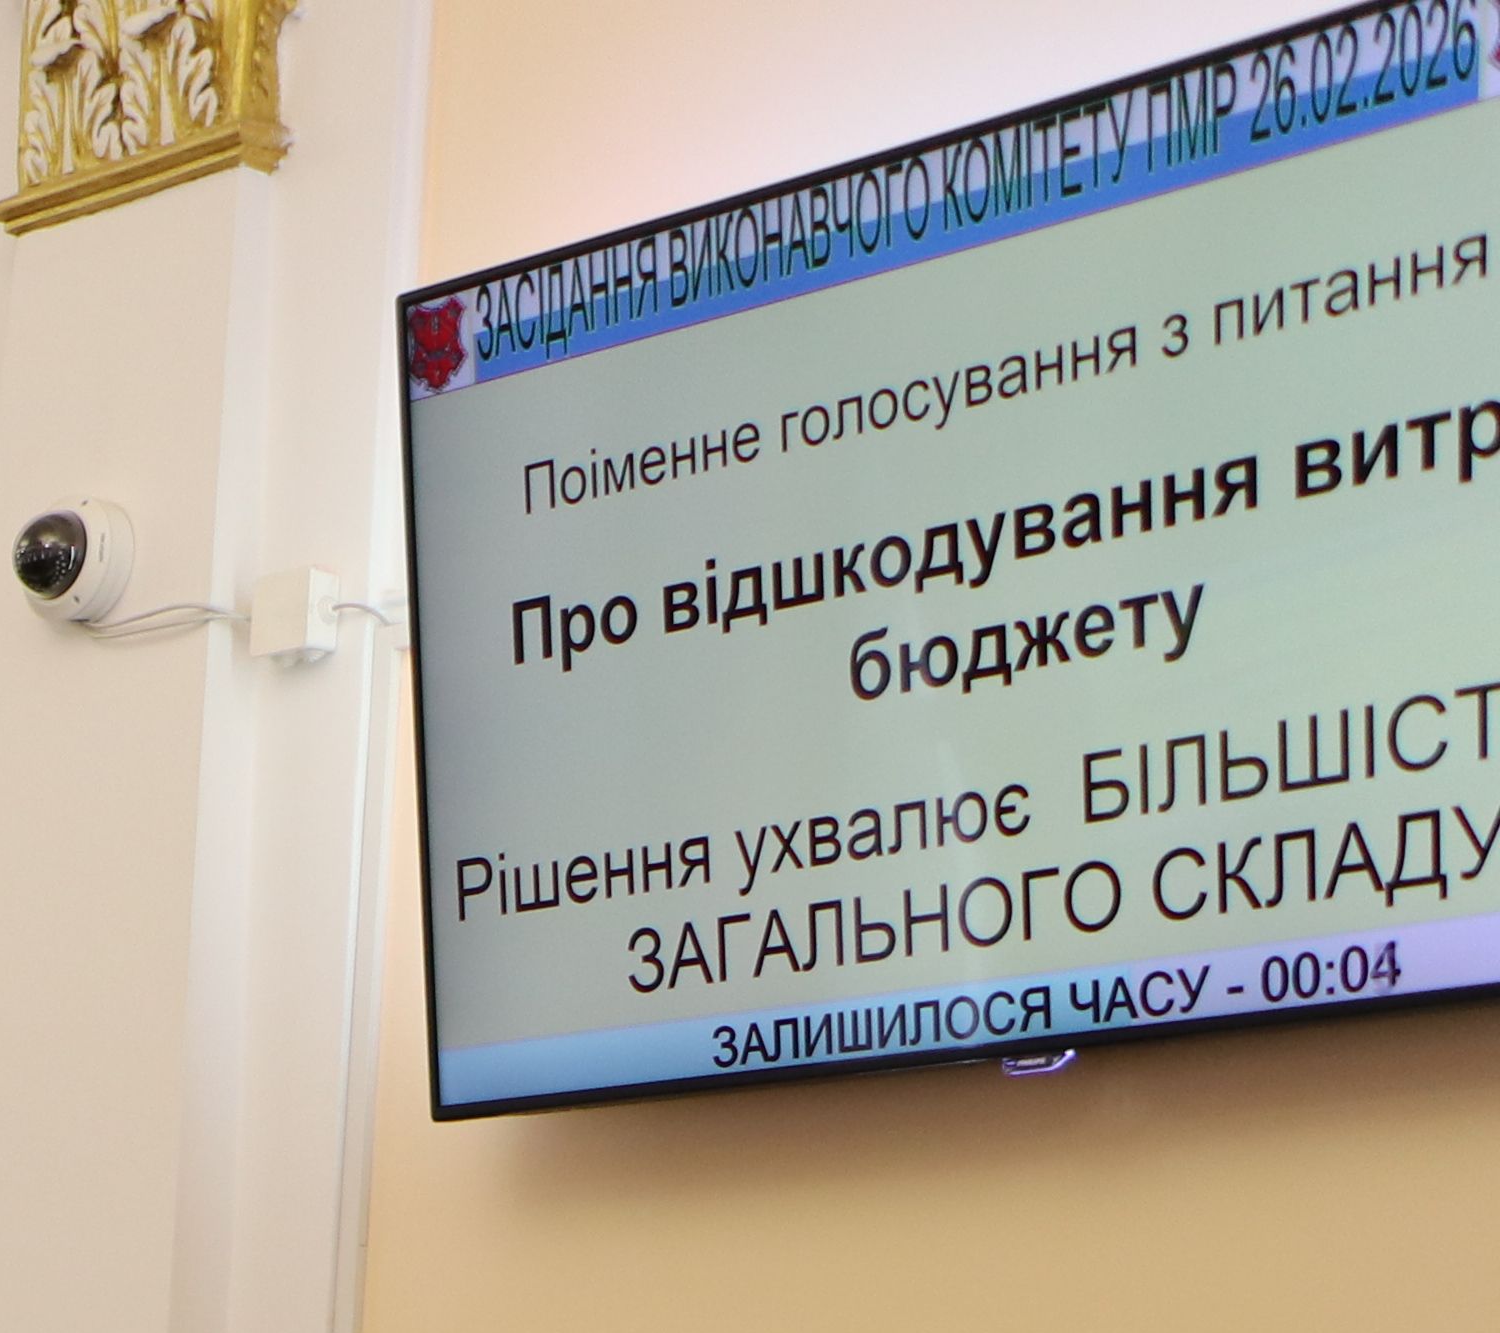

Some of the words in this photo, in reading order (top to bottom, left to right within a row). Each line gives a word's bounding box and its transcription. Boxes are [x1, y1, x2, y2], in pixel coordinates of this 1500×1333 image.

[475, 235, 658, 361] ЗАСІДАННЯ
[668, 156, 931, 307] ВИКОНАВЧОГО
[942, 90, 1134, 231] КОМІТЕТУ
[1147, 60, 1238, 173] ПМР
[1250, 0, 1478, 143] 26.02.2026
[523, 421, 761, 514] Поіменне
[781, 325, 1138, 453] голосування
[1161, 313, 1190, 357] з
[1213, 233, 1489, 346] питання
[512, 594, 638, 672] Про
[662, 455, 1258, 634] відшкодування
[1294, 399, 1500, 500] витр
[849, 583, 1205, 701] бюджету
[456, 835, 711, 921] Рішення
[734, 783, 1031, 896] ухвалює
[1082, 681, 1500, 825] БІЛЬШІСТ
[627, 860, 1122, 994] ЗАГАЛЬНОГО
[1152, 805, 1500, 921] СКЛАДУ
[712, 985, 1052, 1068] ЗАЛИШИЛОСЯ
[1069, 964, 1211, 1024] ЧАСУ
[1261, 940, 1402, 1002] 00:04
